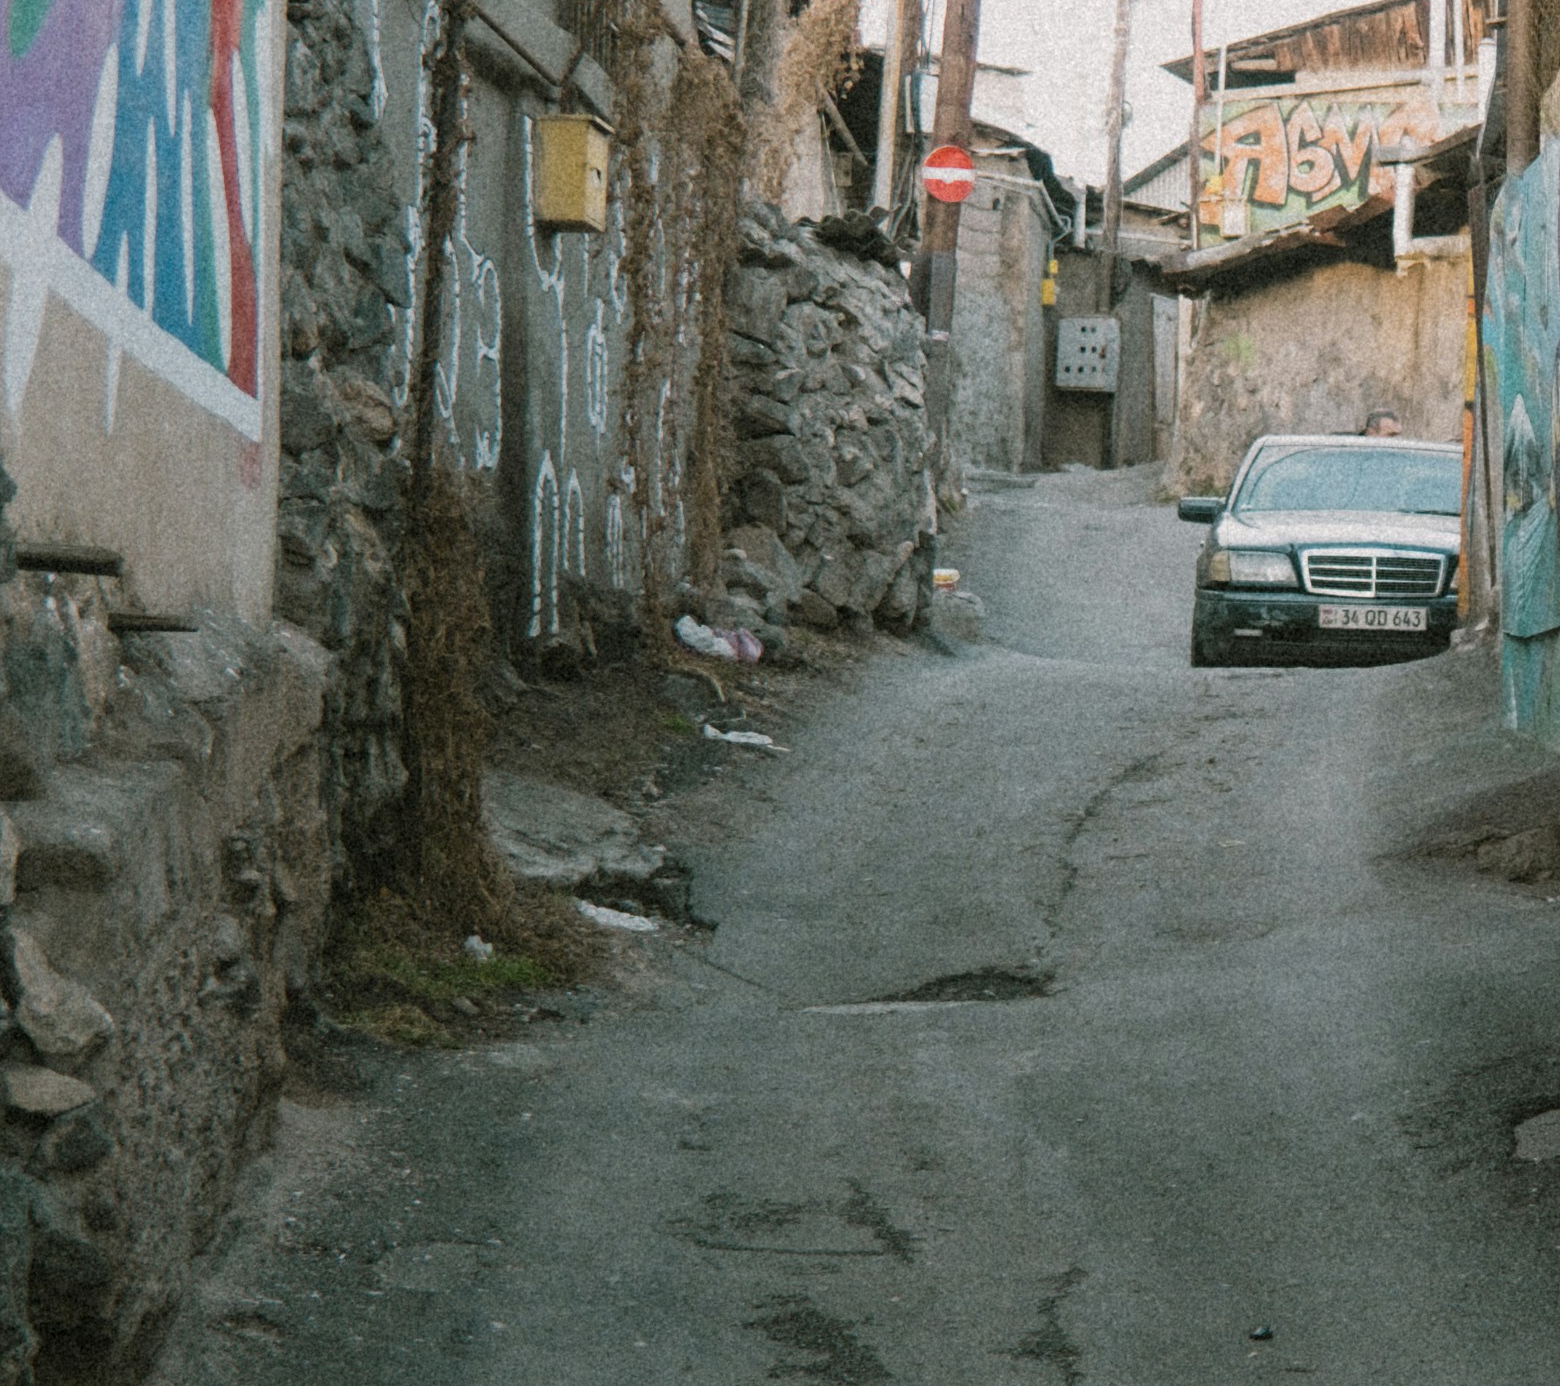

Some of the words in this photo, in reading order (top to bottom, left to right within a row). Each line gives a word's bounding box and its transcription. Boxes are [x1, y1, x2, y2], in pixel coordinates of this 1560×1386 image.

[1341, 609, 1359, 625] 34
[1365, 610, 1387, 626] QD
[1392, 611, 1421, 627] 643
